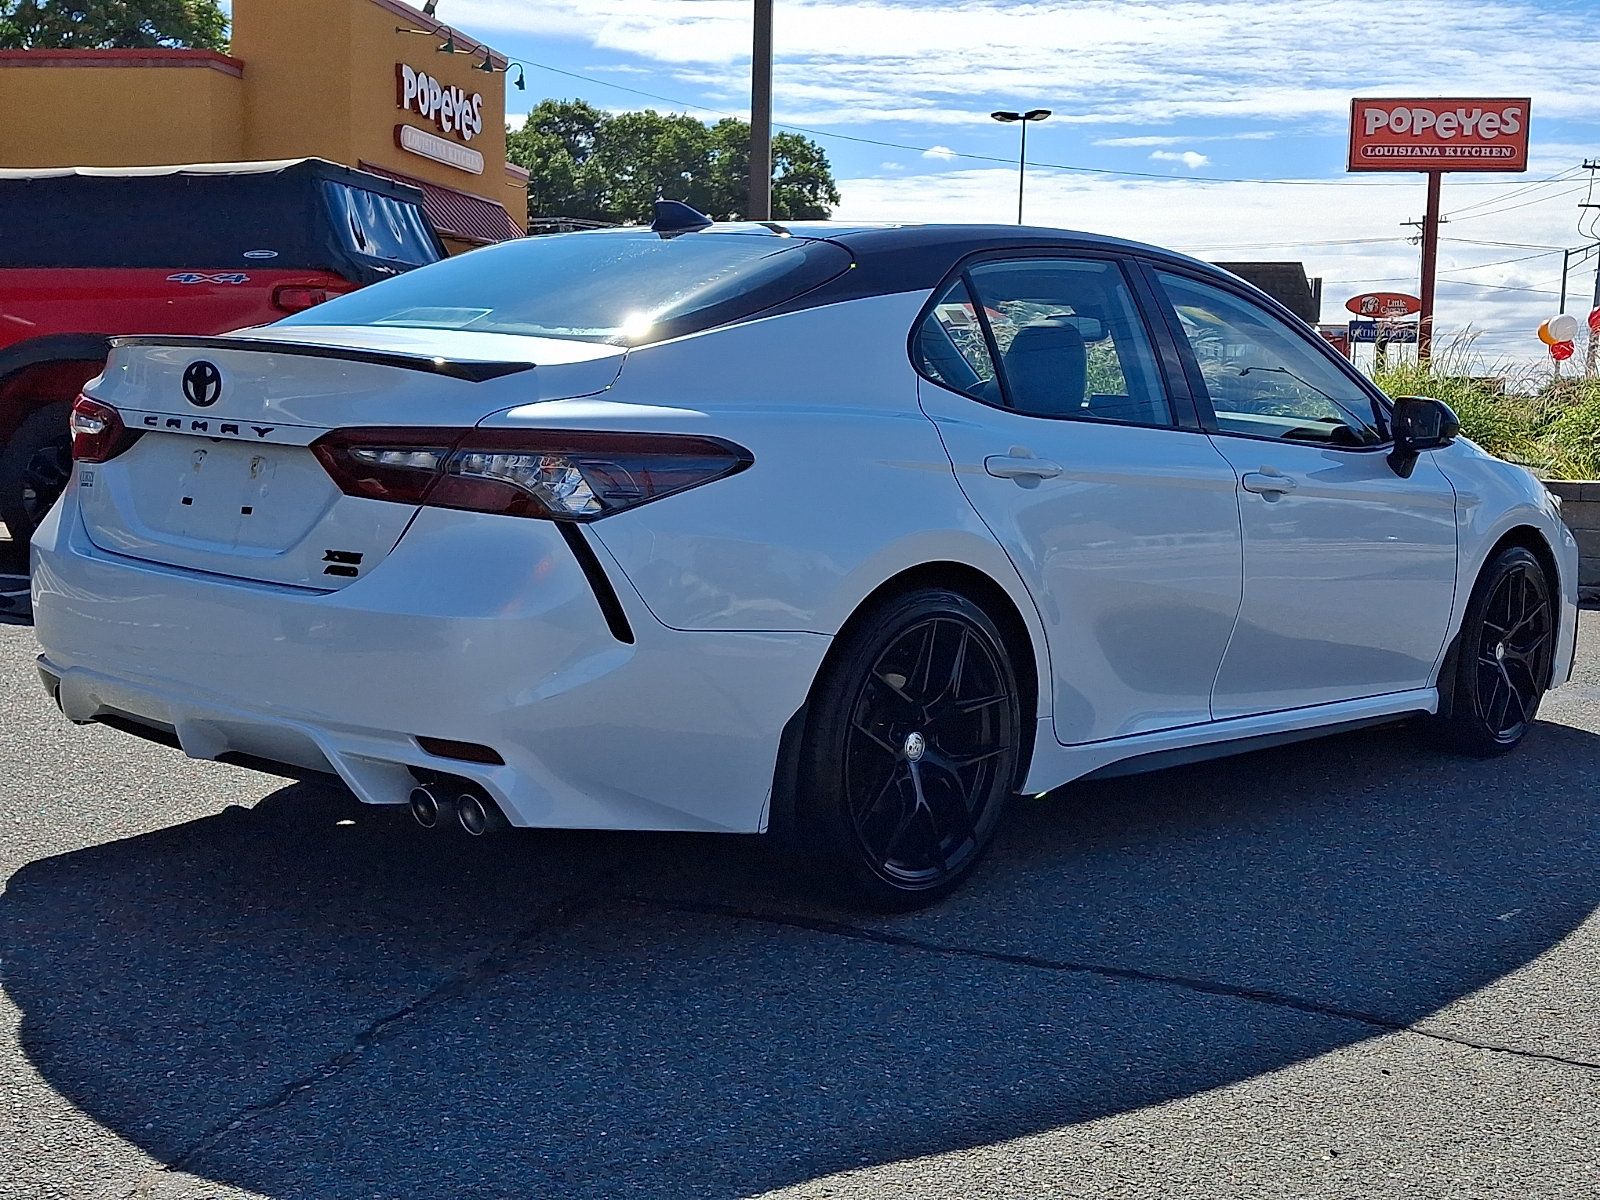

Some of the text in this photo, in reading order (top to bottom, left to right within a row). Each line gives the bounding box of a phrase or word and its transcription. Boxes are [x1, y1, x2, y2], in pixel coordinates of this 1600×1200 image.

[1364, 106, 1521, 139] POPeYeS
[1366, 147, 1512, 158] LOUISIANA KITCHEN
[143, 416, 275, 438] CAMRY
